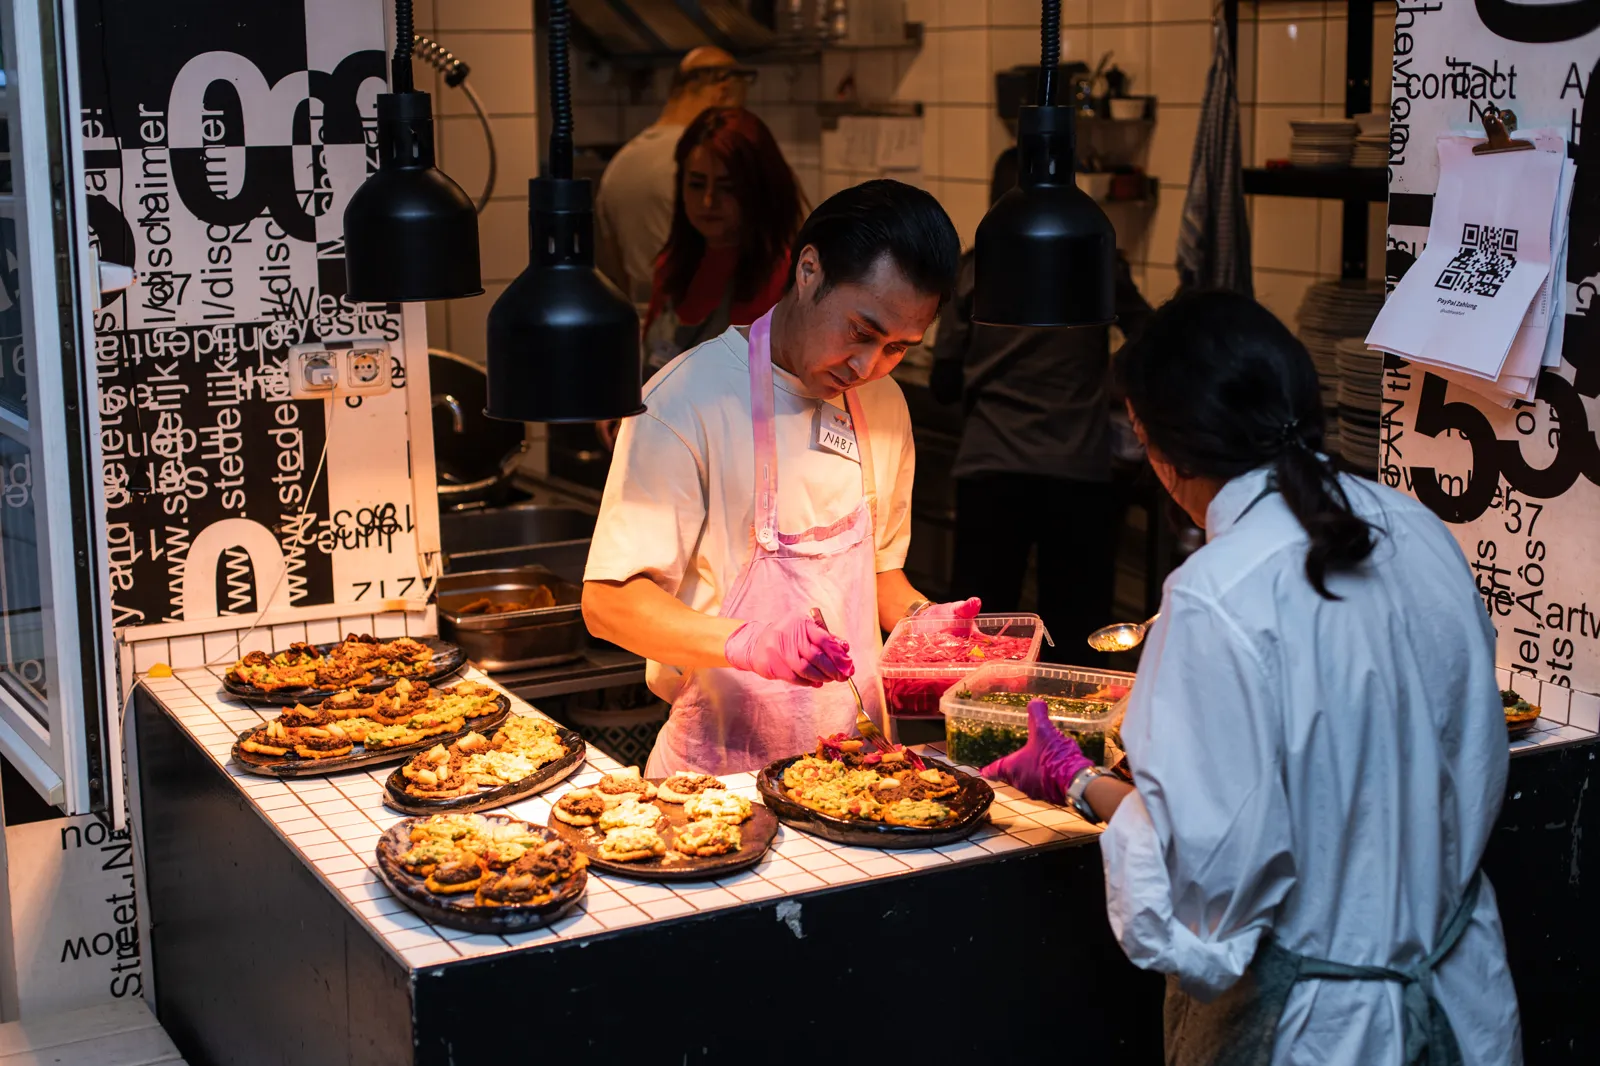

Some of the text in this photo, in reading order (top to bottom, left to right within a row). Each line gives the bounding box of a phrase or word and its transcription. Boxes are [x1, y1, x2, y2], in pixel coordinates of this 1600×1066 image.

[1436, 297, 1478, 311] PayPal Zahlung
[823, 431, 854, 454] NABI
